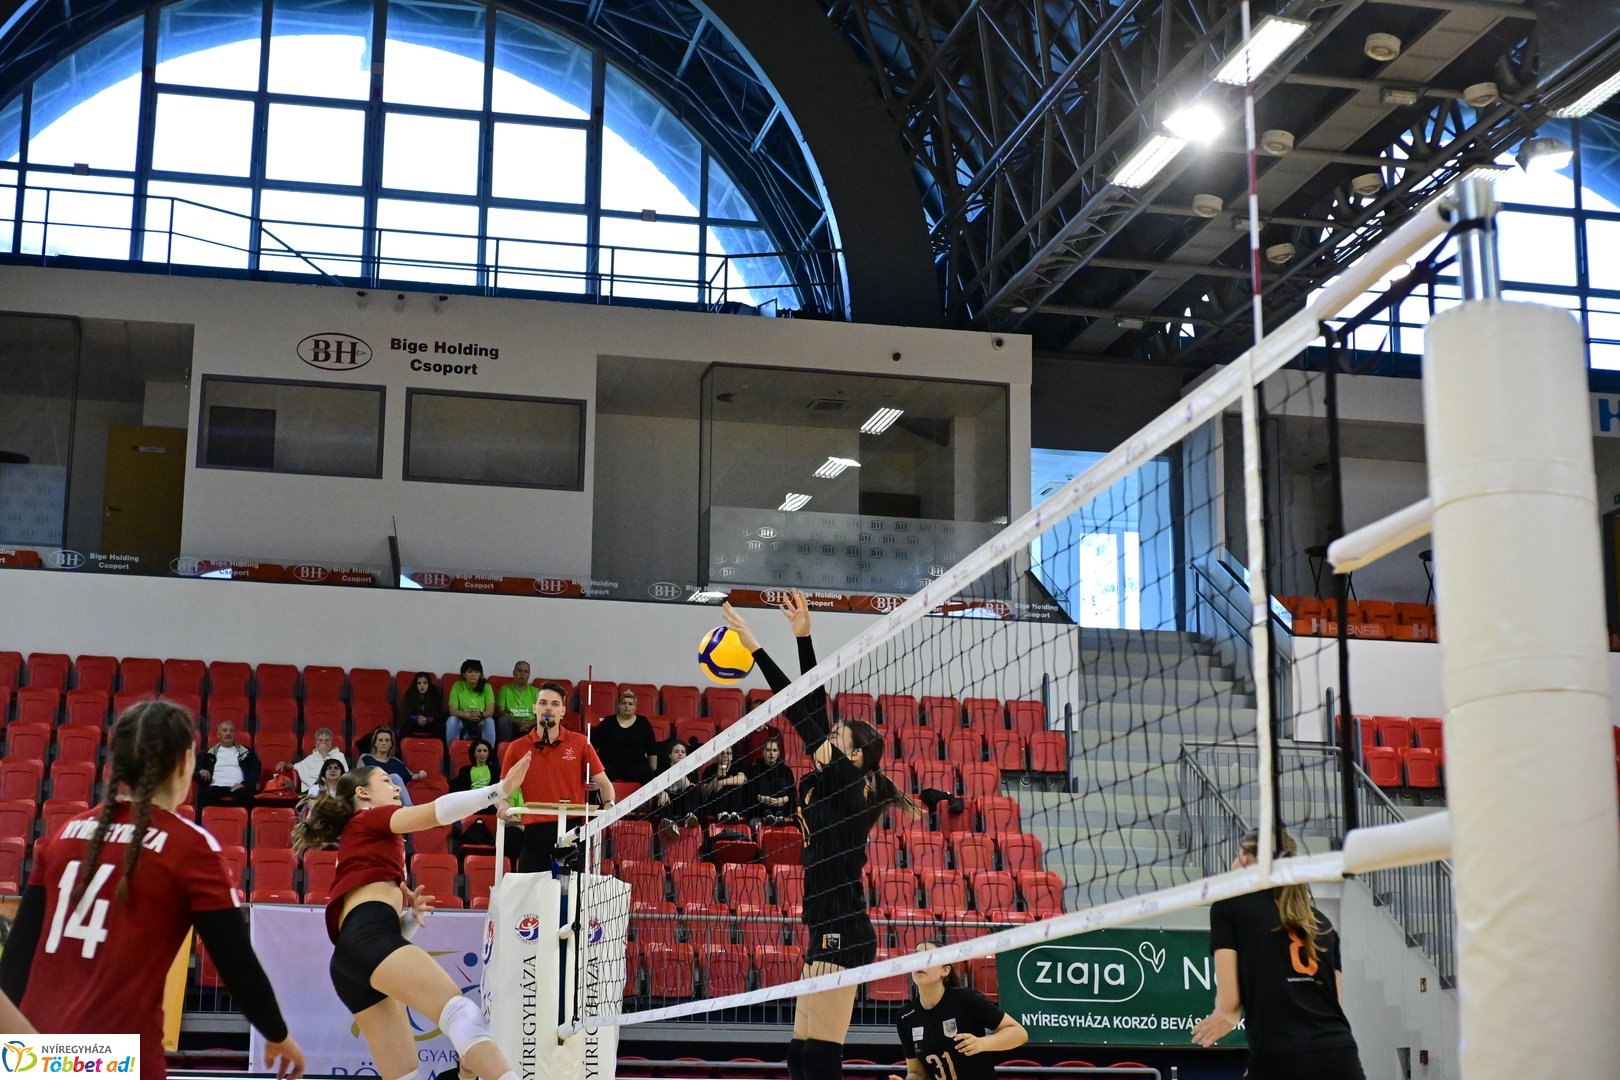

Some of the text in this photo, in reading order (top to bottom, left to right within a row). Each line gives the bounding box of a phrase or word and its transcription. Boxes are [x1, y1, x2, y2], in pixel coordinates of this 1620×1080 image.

[311, 338, 359, 365] BH
[390, 338, 499, 360] Bige Holding
[410, 358, 478, 376] Csoport
[56, 552, 78, 566] BH
[89, 552, 140, 562] Bige Holding
[98, 562, 130, 570] Csoport
[210, 560, 259, 569] Bige Holding
[300, 568, 322, 579] BH
[342, 575, 372, 583] Csoport
[424, 574, 445, 586] BH
[540, 580, 561, 592] BH
[591, 580, 618, 588] Holding
[580, 588, 610, 596] Coport
[654, 586, 675, 597] BH
[815, 592, 842, 600] Holding
[878, 597, 896, 610] BH
[1032, 603, 1058, 611] Holding
[1329, 623, 1380, 636] HBNER
[45, 860, 116, 959] 14
[1183, 956, 1218, 990] N
[520, 955, 536, 1080] YÍREGYHÁZA
[583, 956, 598, 1080] YÍREGYHÁZA
[1022, 1010, 1109, 1028] NYÍREGYHÁZA
[1114, 1014, 1156, 1029] KORZÓ
[926, 1051, 958, 1080] 31
